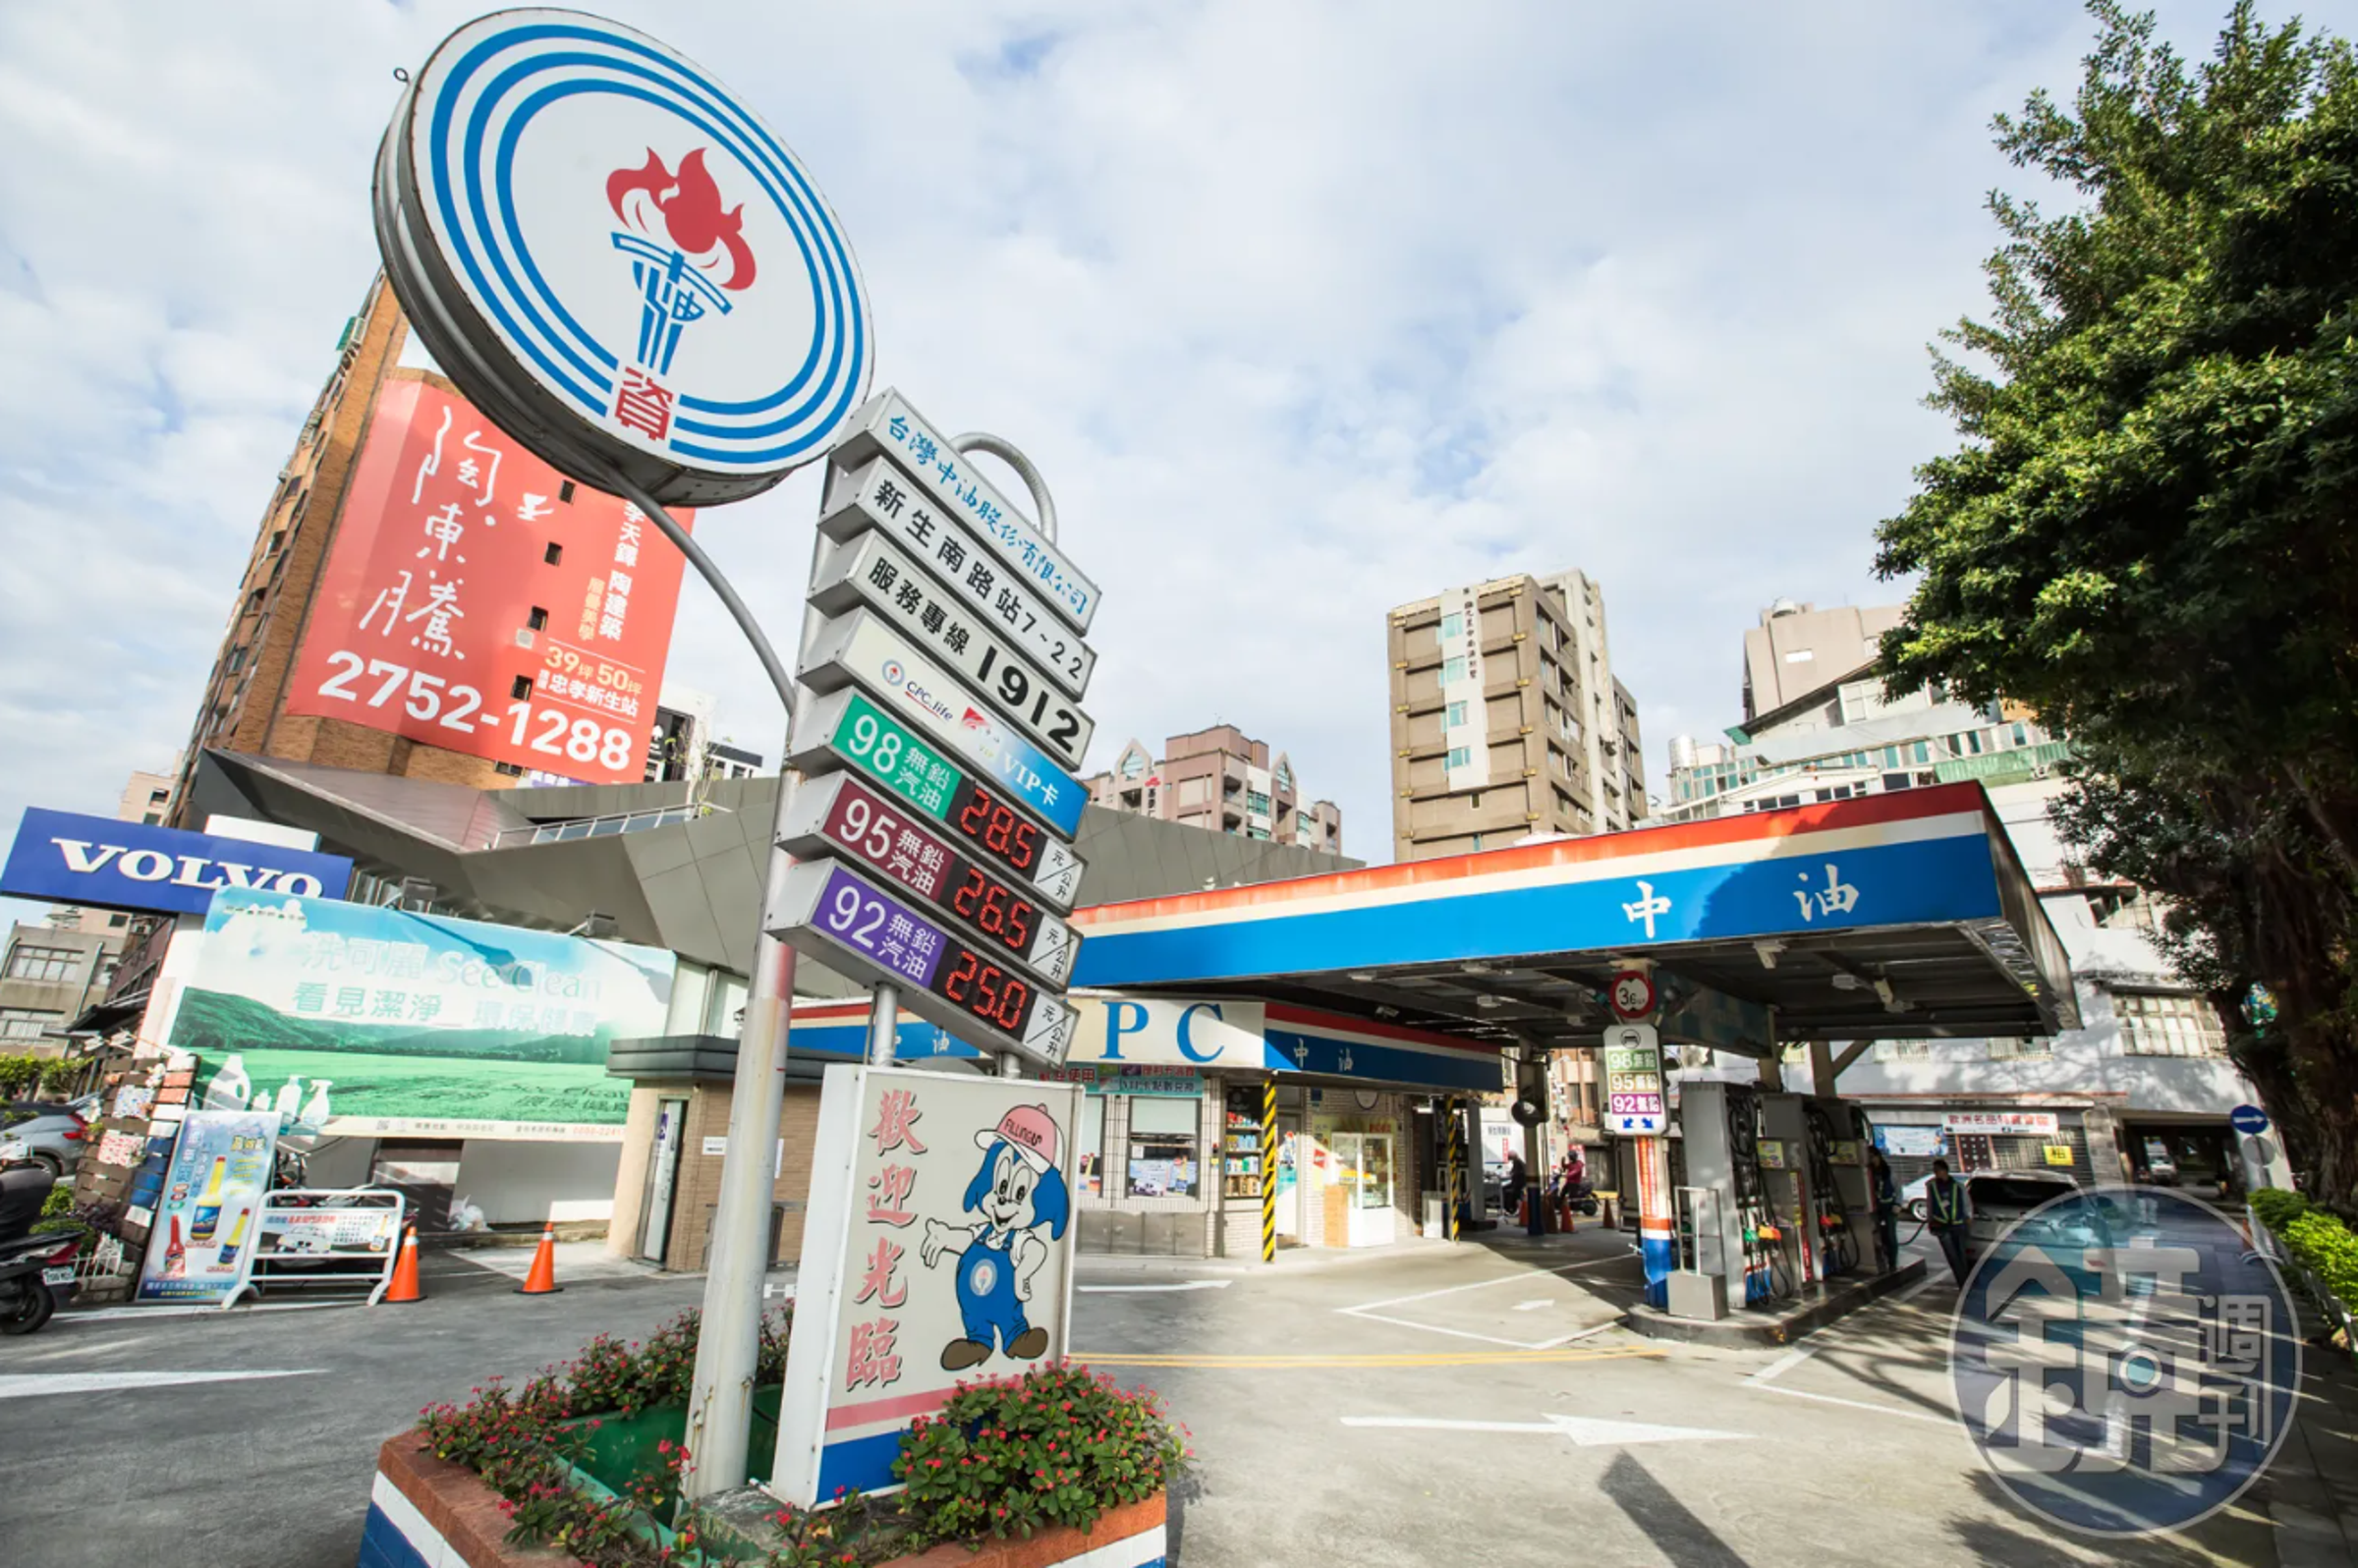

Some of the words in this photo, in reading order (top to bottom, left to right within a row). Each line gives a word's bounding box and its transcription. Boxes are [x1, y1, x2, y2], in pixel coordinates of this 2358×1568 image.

[615, 366, 673, 441] 資
[888, 415, 1089, 616] 台灣中油股份有限公司
[868, 556, 971, 656] 服務專線
[977, 644, 1080, 755] 1912
[317, 649, 633, 772] 2752-1288
[848, 713, 903, 774] 98
[1003, 752, 1059, 807] VIP卡
[839, 798, 898, 860] 95
[959, 788, 1038, 870] 28.5
[50, 837, 323, 899] VOLVO
[827, 885, 885, 950] 92
[952, 868, 1034, 950] 26.5
[302, 933, 429, 980] 洗可麗
[436, 950, 501, 989] See
[514, 960, 601, 1003] Clean
[293, 980, 442, 1022] 看見潔淨
[944, 951, 1028, 1031] 25.0
[1098, 1000, 1225, 1064] PC
[846, 1088, 927, 1392] 歡迎光臨
